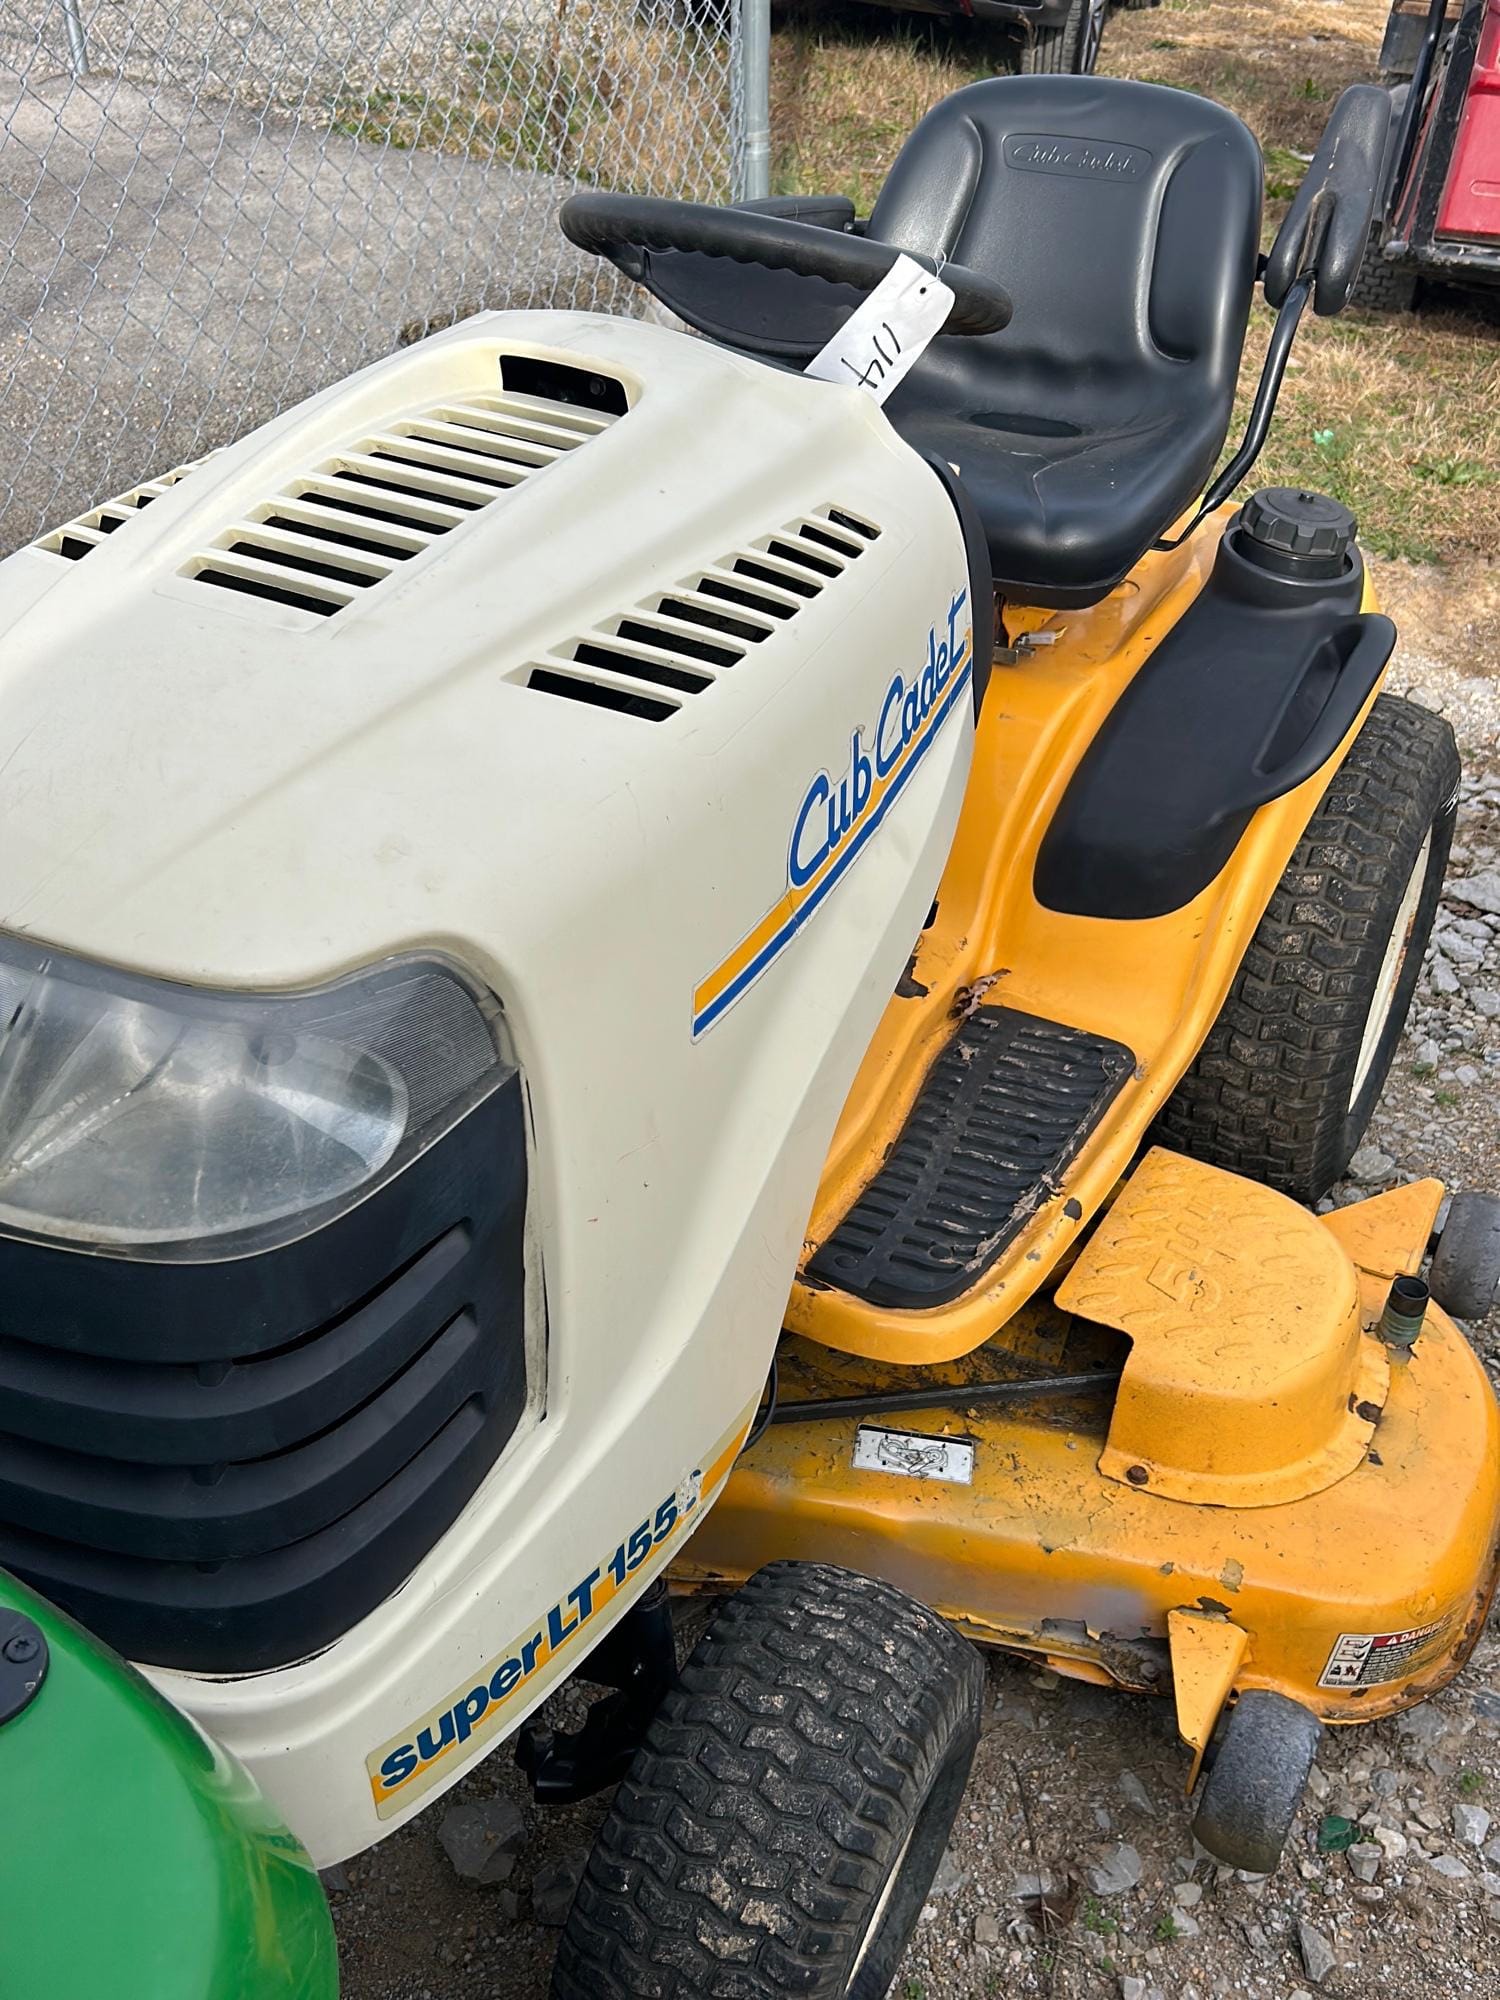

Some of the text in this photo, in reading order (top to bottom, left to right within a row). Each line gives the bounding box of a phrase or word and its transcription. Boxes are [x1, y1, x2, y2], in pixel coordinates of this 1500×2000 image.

[841, 322, 901, 389] 114
[789, 588, 967, 887] Cub Cadet
[380, 1632, 542, 1788] super
[547, 1567, 601, 1651] LT
